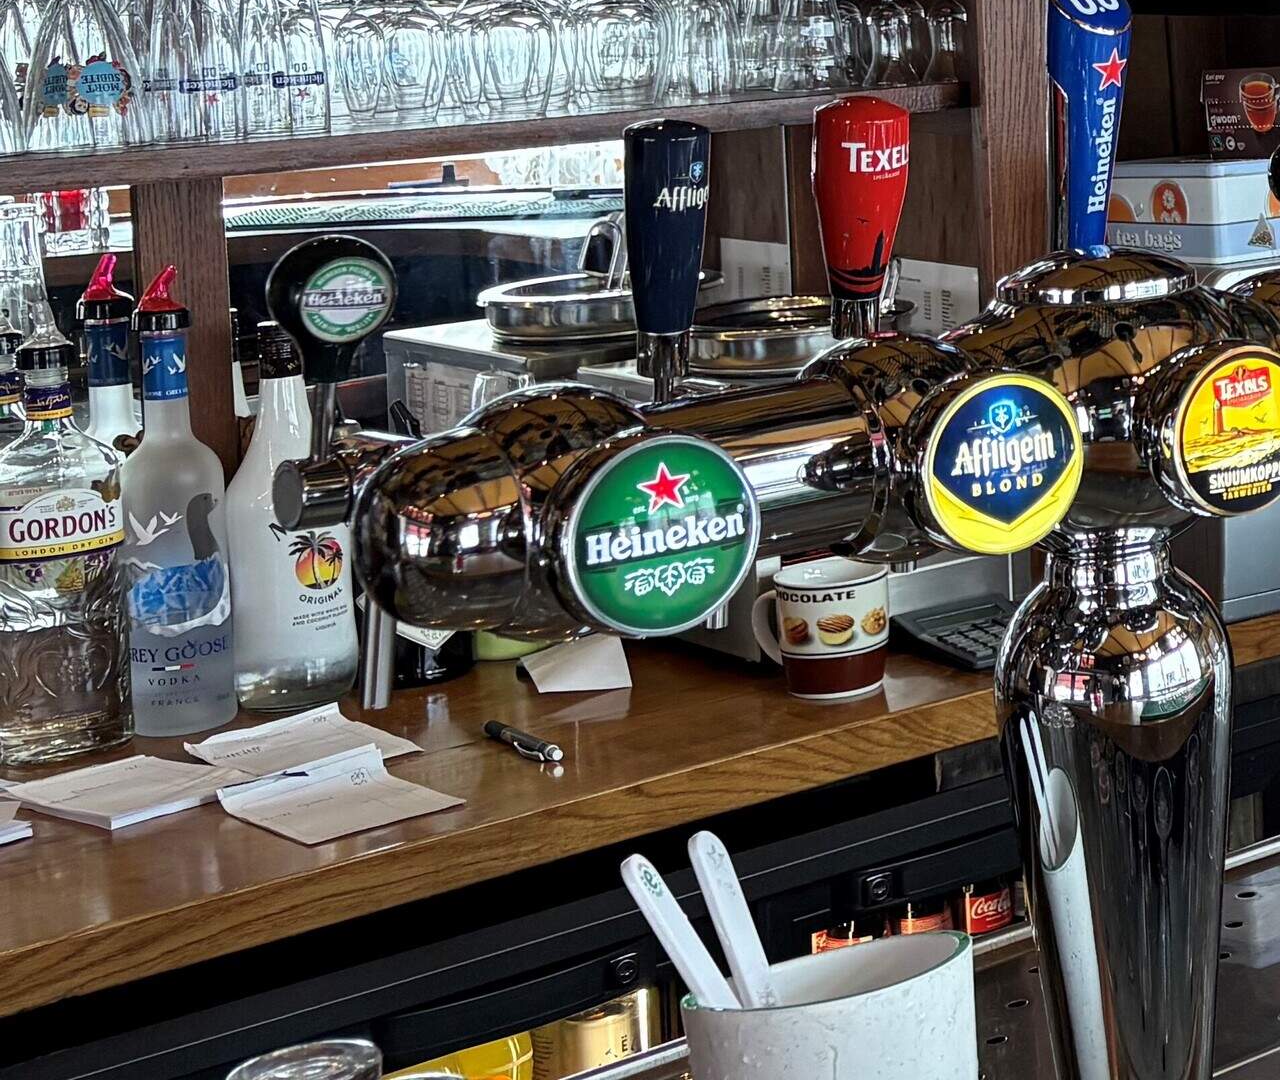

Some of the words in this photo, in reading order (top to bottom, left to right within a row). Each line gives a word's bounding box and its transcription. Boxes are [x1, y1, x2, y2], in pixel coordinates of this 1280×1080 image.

[81, 73, 121, 85] SUBITE
[85, 83, 121, 94] MORT
[1087, 98, 1117, 214] Heineken
[1115, 228, 1141, 247] tea
[1144, 229, 1183, 251] bags
[950, 431, 1057, 478] Affligem
[972, 473, 1025, 499] BLOND
[9, 504, 116, 544] GORDON'S
[15, 546, 65, 557] LONDON
[72, 541, 92, 551] DRY
[98, 536, 114, 546] GIN
[586, 507, 748, 566] Heineken
[299, 586, 344, 605] ORIGINAL
[776, 589, 856, 604] HOCOLATE
[128, 648, 159, 663] REY
[148, 675, 200, 687] VODKA
[151, 697, 200, 707] FRANCE
